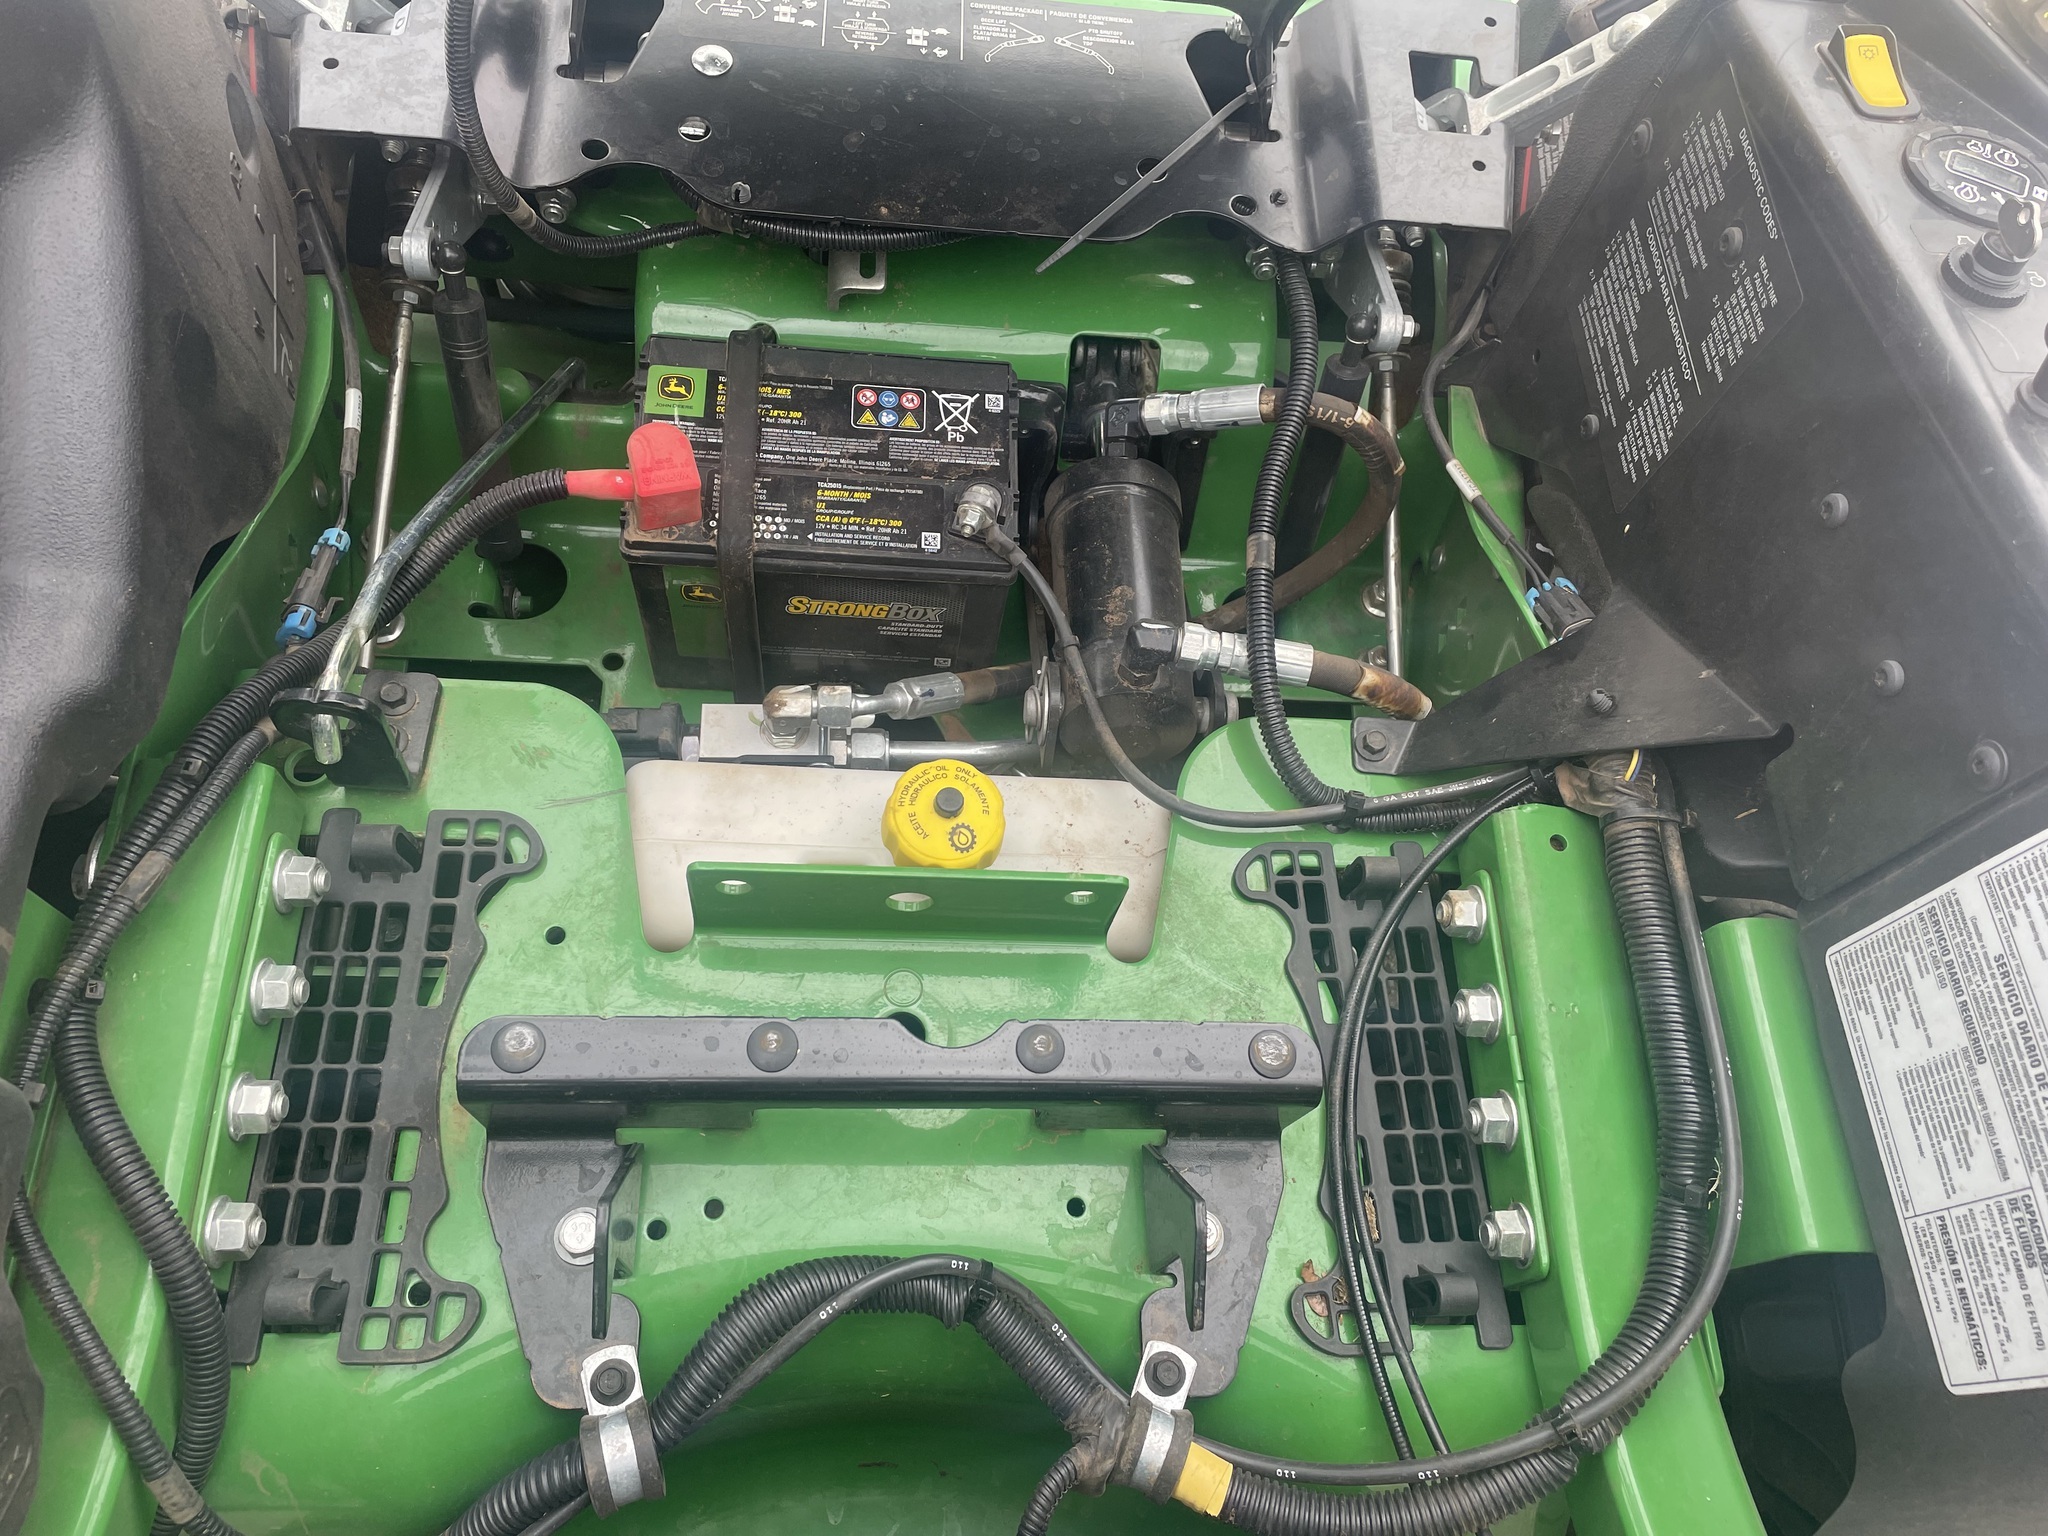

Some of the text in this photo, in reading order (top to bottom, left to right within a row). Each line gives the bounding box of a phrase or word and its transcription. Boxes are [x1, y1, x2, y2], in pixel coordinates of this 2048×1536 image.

[970, 2, 1044, 15] CONVENIENCE PACKAGE
[1049, 10, 1078, 19] PAQUETE
[1088, 14, 1133, 24] CONVENIENCIA
[1709, 118, 1727, 170] VIOLATIONS
[1716, 109, 1734, 159] INTERLOCK
[1739, 128, 1763, 196] DIAGNOSTIC
[1646, 227, 1662, 275] CODIGOS
[1658, 274, 1670, 306] PARA
[1753, 272, 1767, 308] FAULTS
[1758, 255, 1777, 307] REAL-TIME
[1723, 300, 1743, 357] SYSTEM ISSUE
[1733, 305, 1747, 341] STARTER
[1736, 285, 1747, 310] WEAK
[1743, 308, 1757, 343] BATTERY
[1743, 276, 1754, 299] OVER
[1750, 297, 1764, 334] VOLTAGE
[1700, 340, 1711, 371] Harness
[1706, 332, 1723, 383] Check Engine
[1710, 317, 1725, 356] DETECTED
[1716, 310, 1729, 341] OUTPUT
[1725, 341, 1736, 366] FAULT
[1660, 368, 1678, 427] TIEMPO REAL
[1667, 366, 1679, 400] FALLAS
[947, 431, 965, 443] Pb
[817, 490, 849, 498] 6-MONTH
[898, 769, 930, 807] HYDRAULIC
[955, 766, 978, 778] ONLY
[908, 812, 930, 840] ACEITE
[954, 774, 990, 815] SOLAMENTE
[1916, 911, 1930, 936] ANTES
[1929, 949, 1941, 971] CADA
[1936, 971, 1947, 988] USO
[1927, 905, 1986, 1064] SERVICIO DIARIO REQUERIDO
[1993, 953, 2023, 1016] SERVICIO
[2016, 1020, 2041, 1067] DIARIO
[2007, 1197, 2037, 1268] DE FLUIDOS
[1936, 1215, 1986, 1369] PRESIÓN DE NEUMÁTICOS:
[1993, 1200, 2015, 1246] (INCLUYE
[2010, 1250, 2028, 1290] CAMBIO
[2027, 1310, 2045, 1350] FILTRO)
